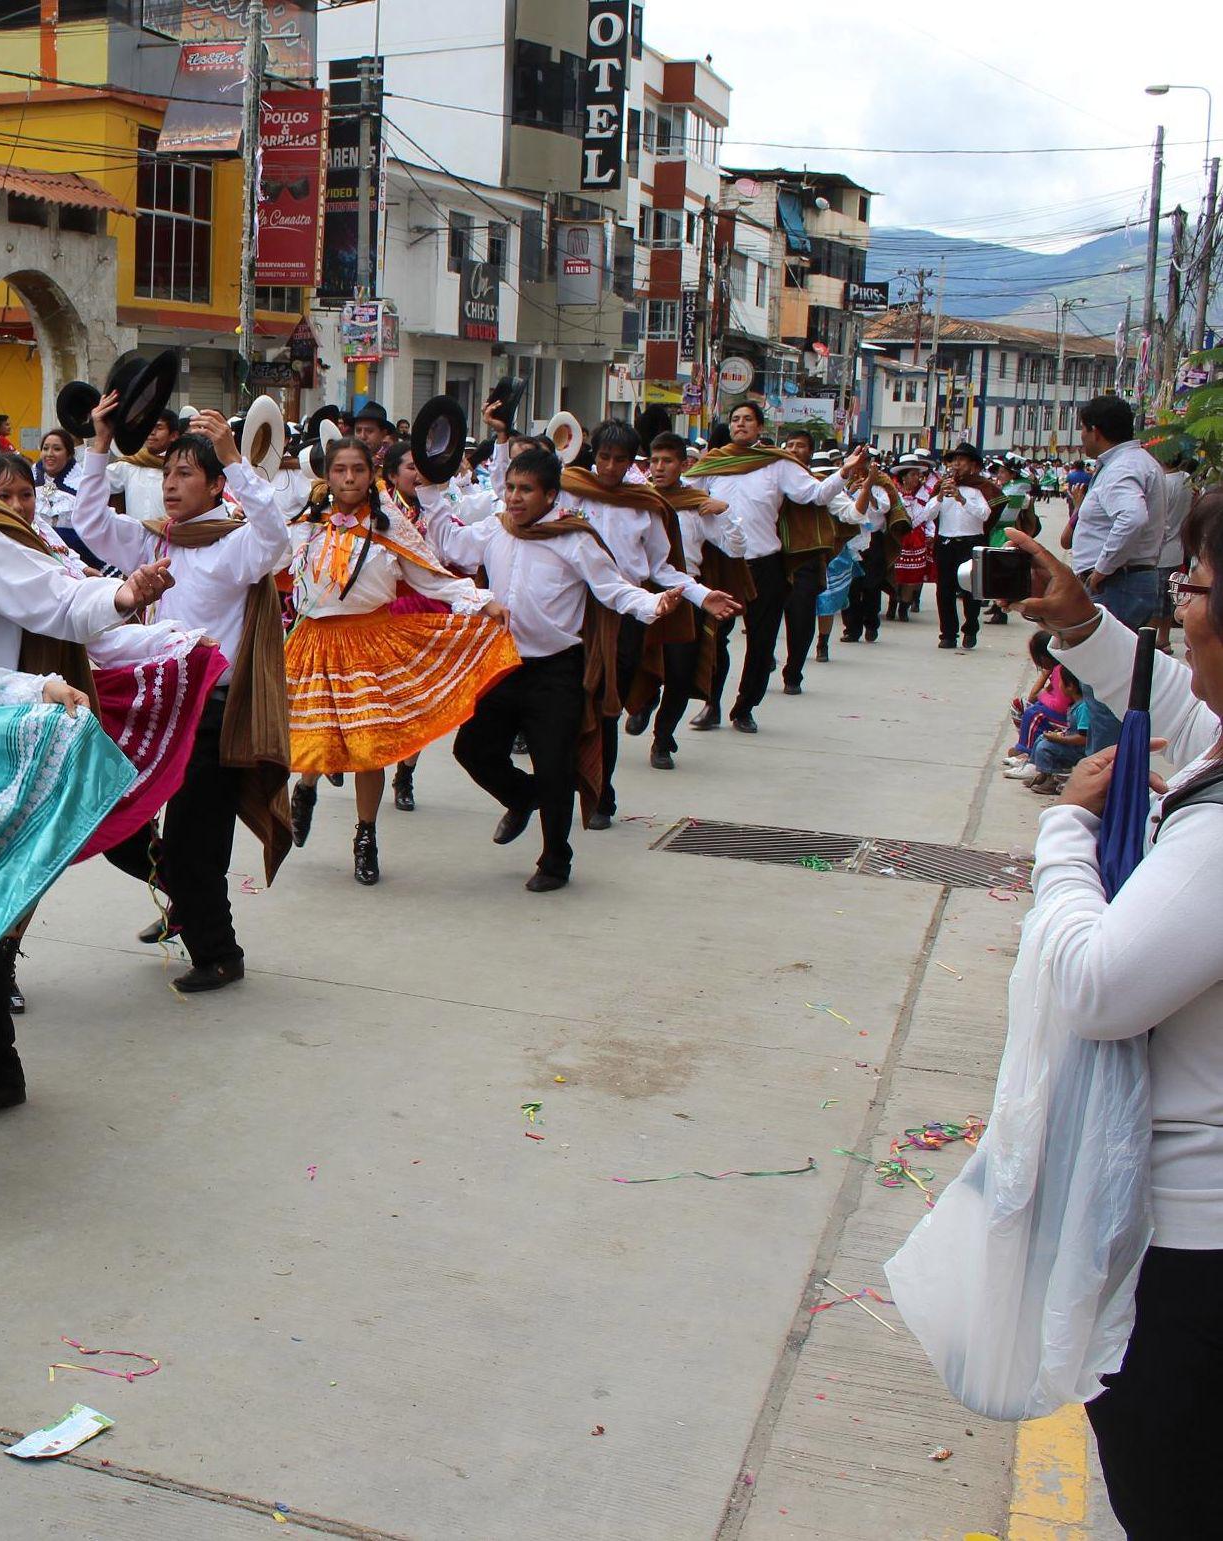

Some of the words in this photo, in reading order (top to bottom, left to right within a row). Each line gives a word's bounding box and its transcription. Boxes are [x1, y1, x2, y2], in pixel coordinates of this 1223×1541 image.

[584, 0, 625, 184] OTEL
[264, 112, 309, 124] POLLOS
[281, 124, 290, 135] &
[326, 145, 376, 168] ARENS
[270, 209, 311, 226] Canasta
[565, 265, 589, 273] AURIS
[685, 292, 696, 347] HOSTAL
